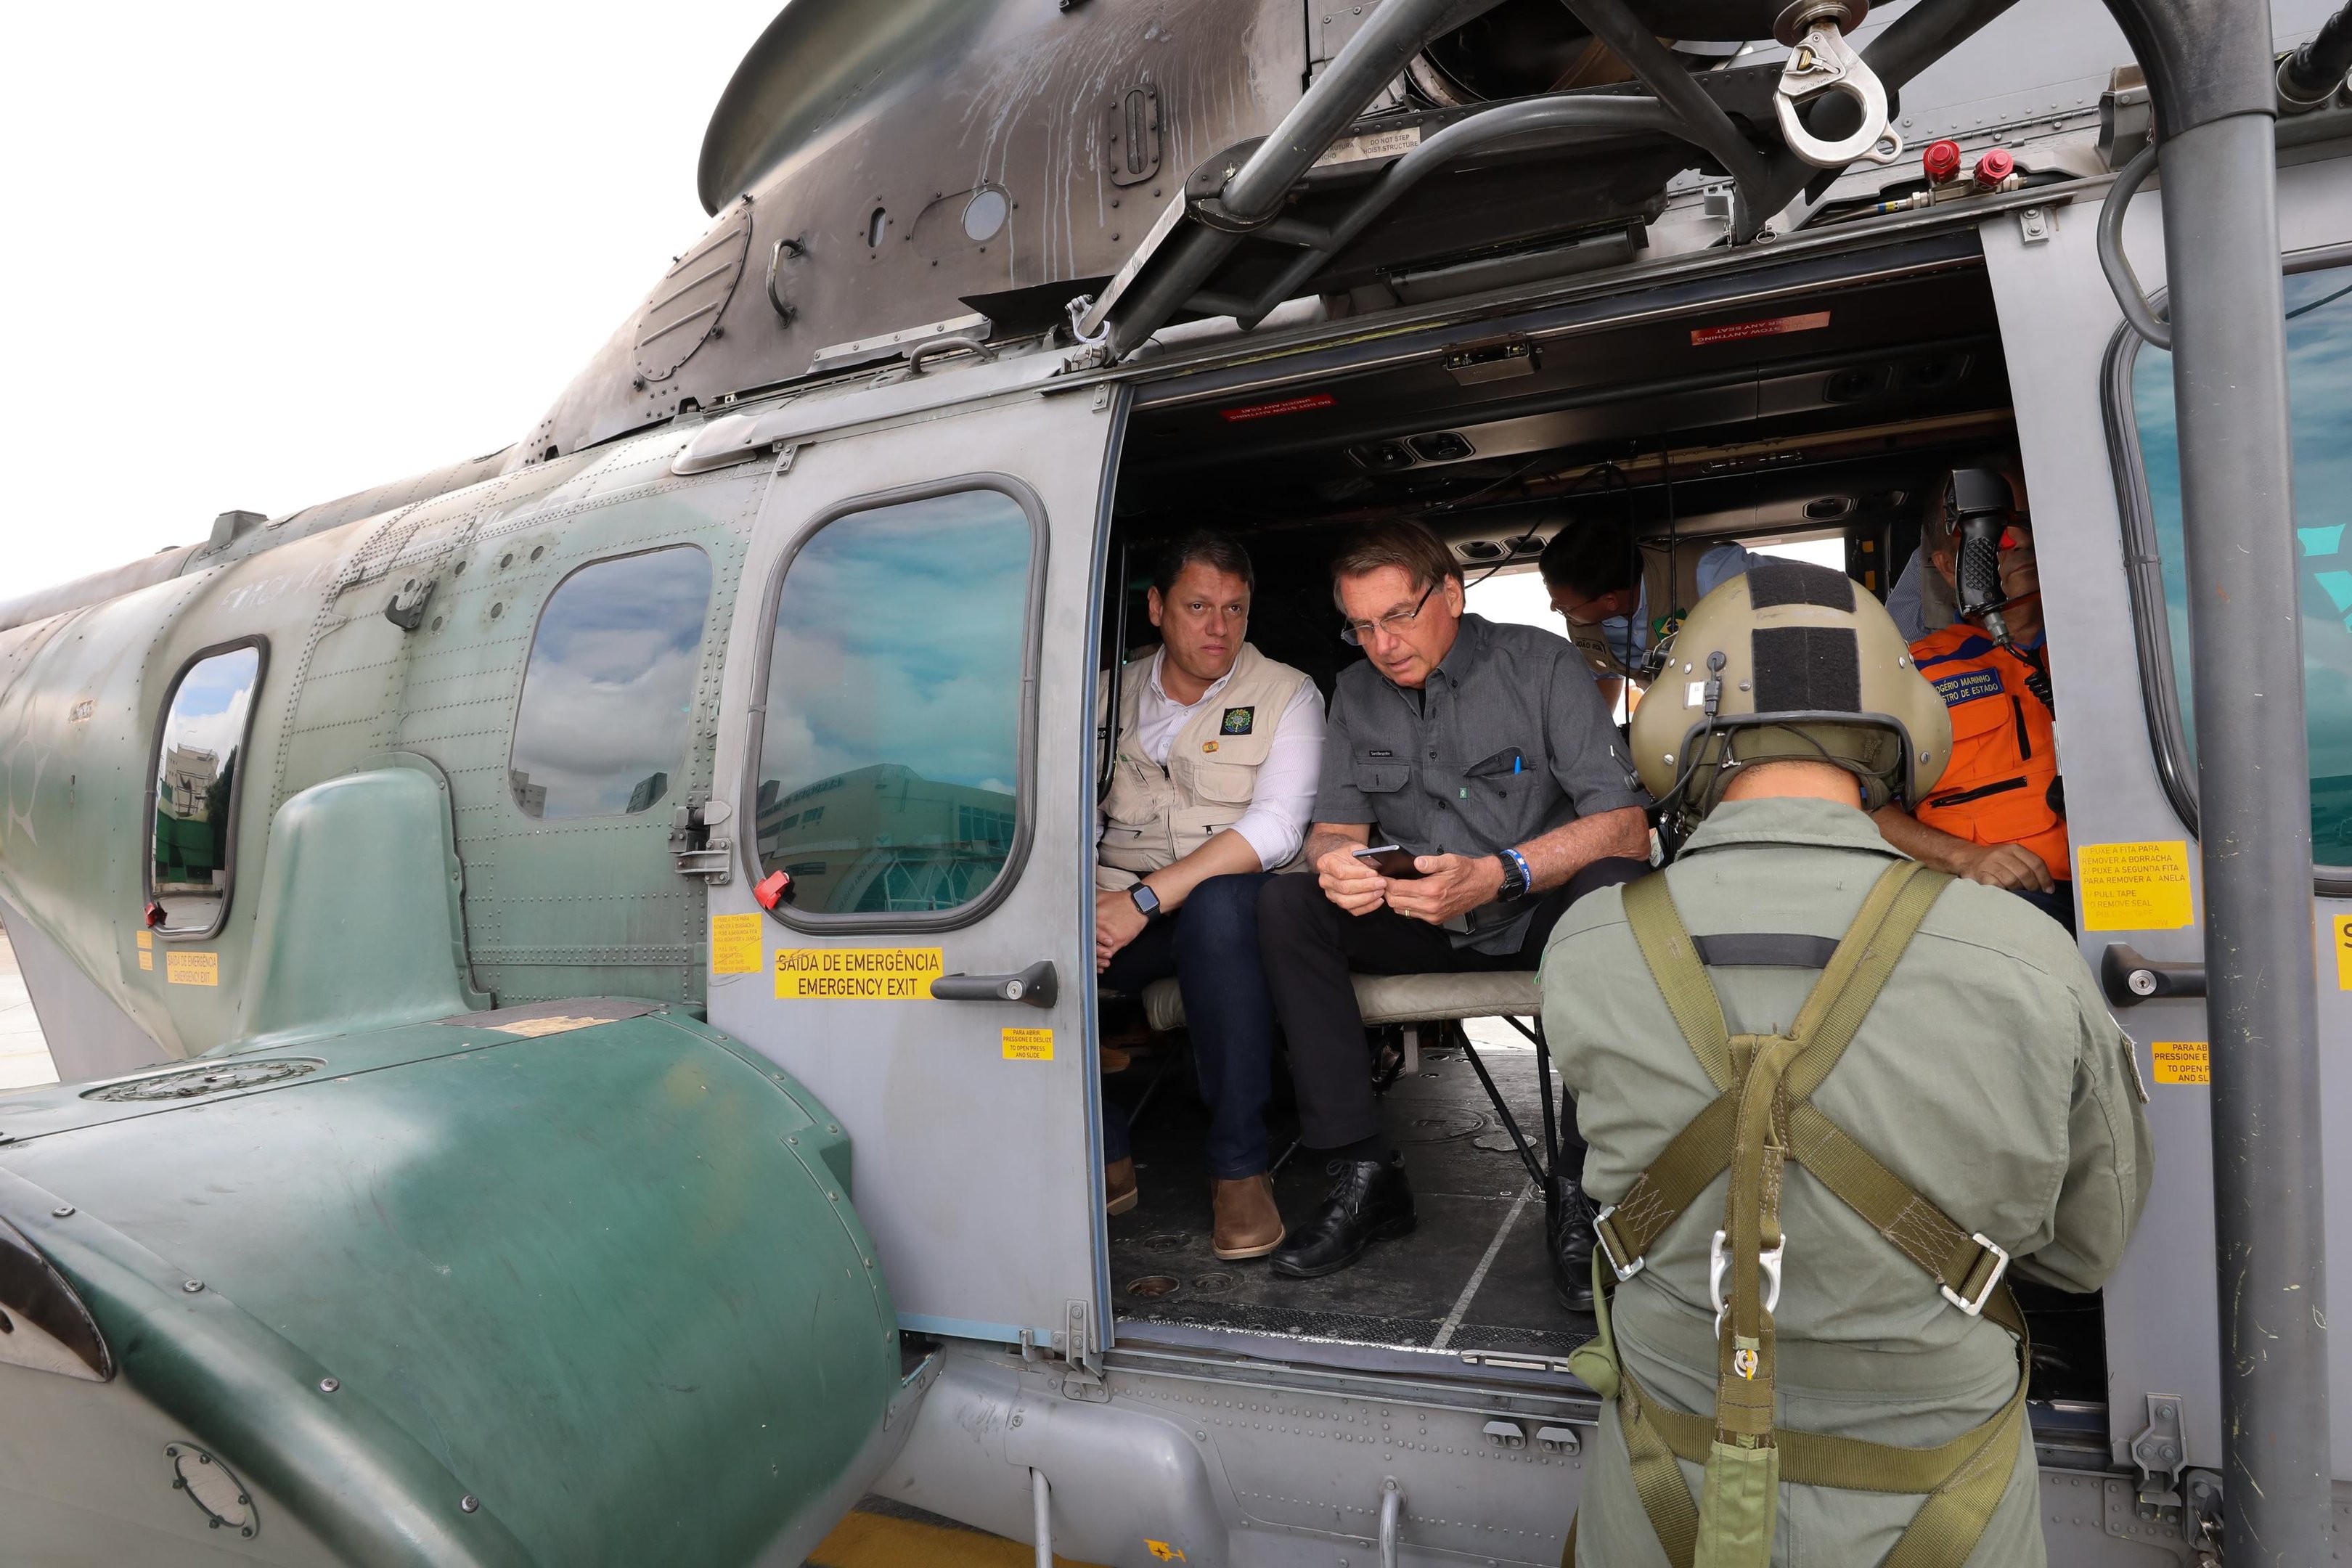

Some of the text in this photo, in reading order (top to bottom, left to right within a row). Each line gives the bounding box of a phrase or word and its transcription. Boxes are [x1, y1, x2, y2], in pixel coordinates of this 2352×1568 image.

[1383, 141, 1418, 151] STRUCTURE
[1697, 332, 1748, 343] ANYTHING
[1230, 410, 1270, 420] ANYTHING
[1936, 675, 1990, 693] OGÉRIO MARINHO
[1942, 683, 1998, 703] STRO DE ESTADO
[778, 950, 939, 971] SAÍDA DE EMERGÊNCIA
[799, 979, 918, 995] EMERGENCY EXIT
